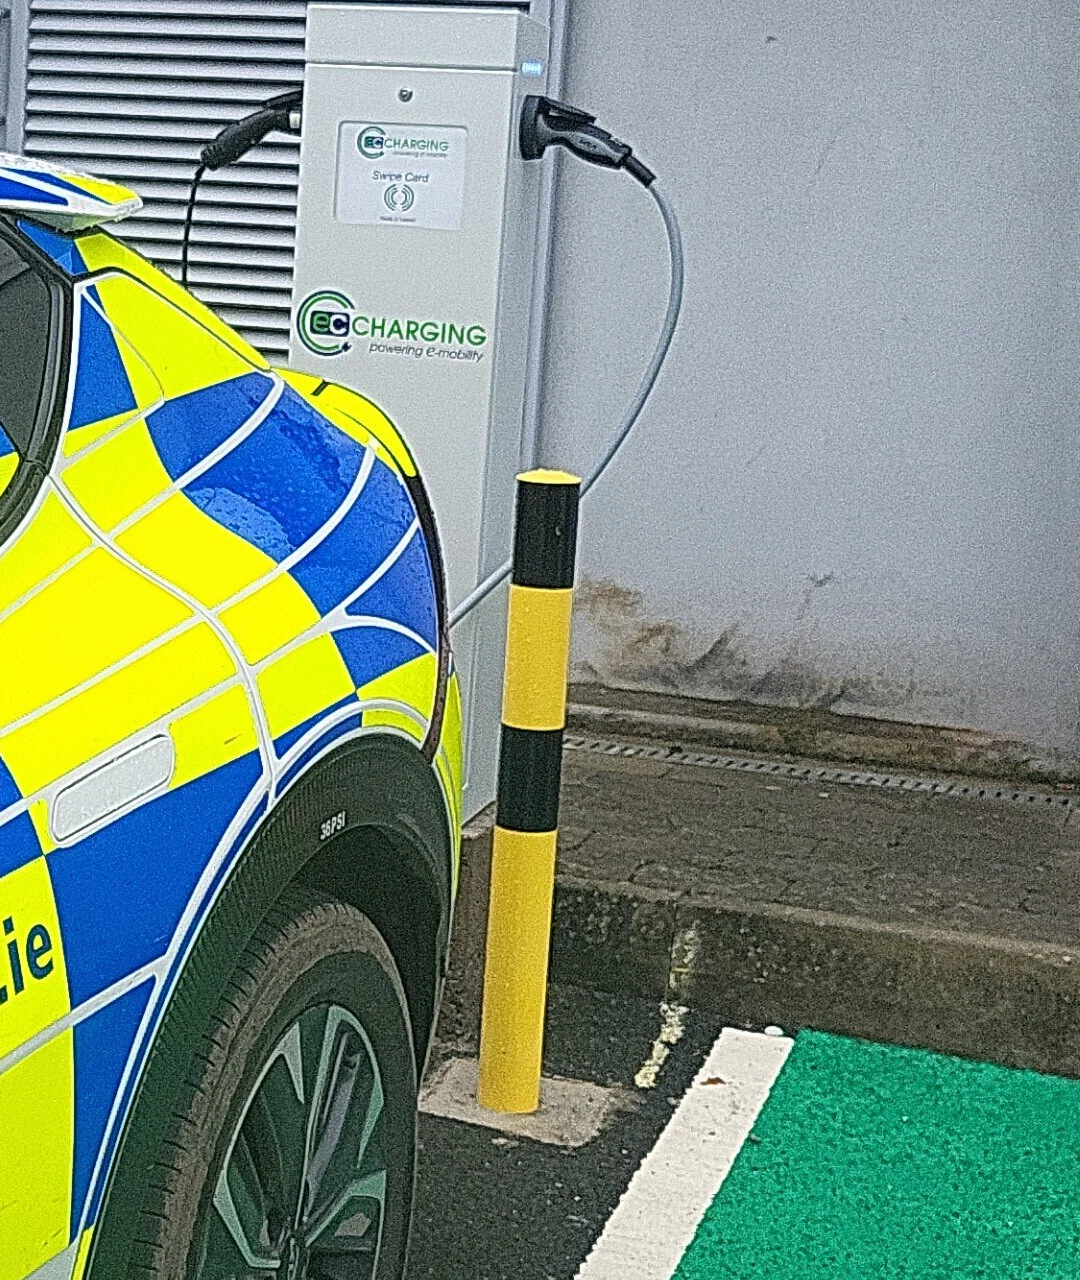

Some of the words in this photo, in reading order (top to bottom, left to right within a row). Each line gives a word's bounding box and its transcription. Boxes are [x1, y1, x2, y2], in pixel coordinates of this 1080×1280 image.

[405, 172, 429, 183] Card
[351, 316, 487, 346] CHARGING
[369, 343, 423, 358] powering
[425, 346, 484, 363] e-mobility
